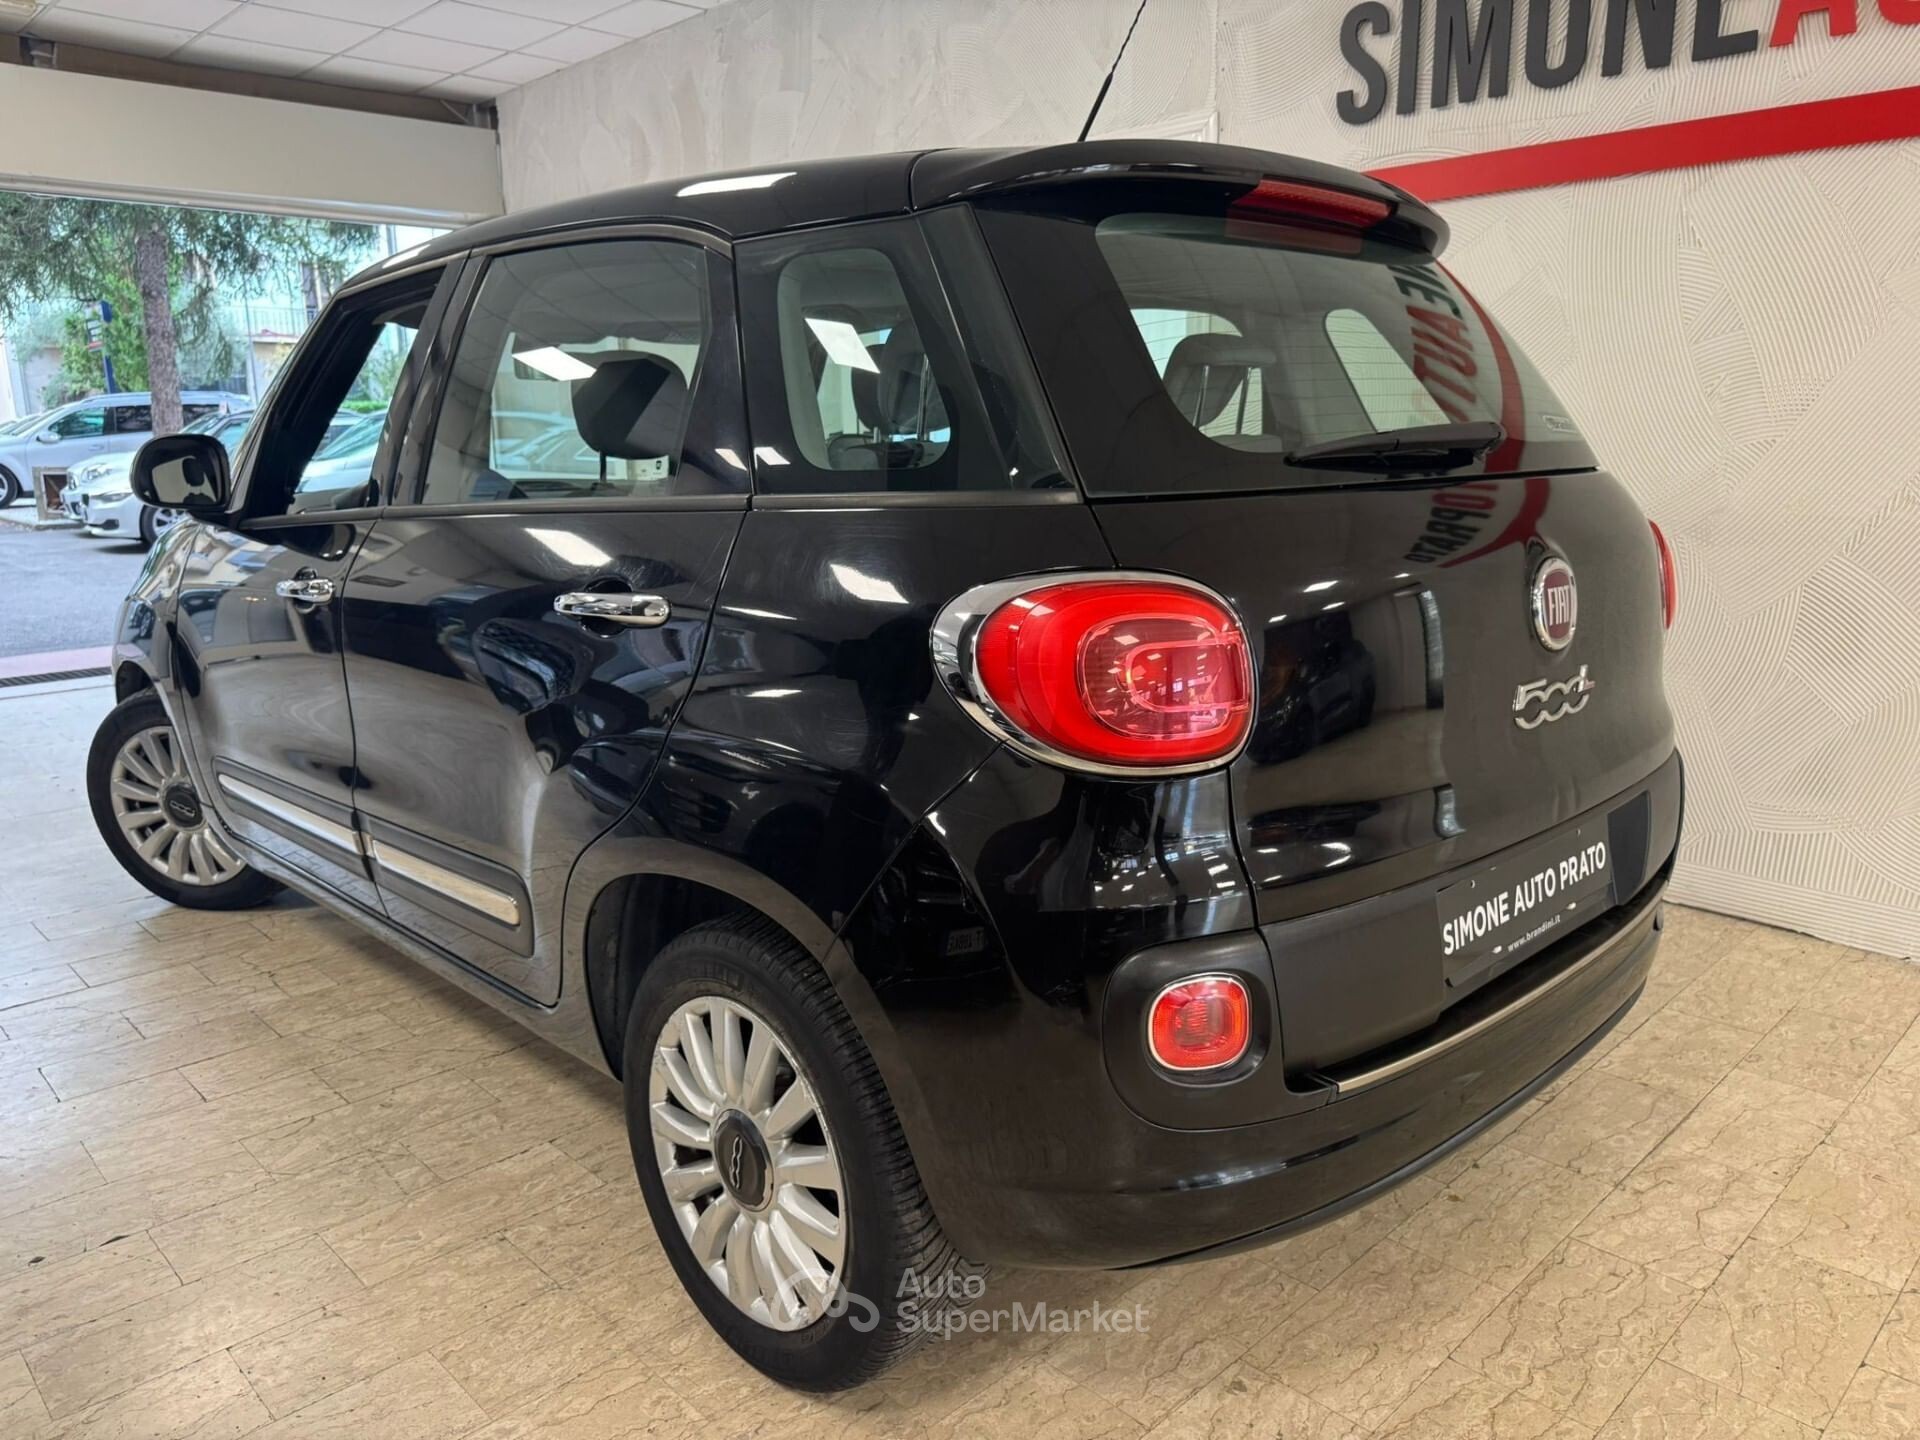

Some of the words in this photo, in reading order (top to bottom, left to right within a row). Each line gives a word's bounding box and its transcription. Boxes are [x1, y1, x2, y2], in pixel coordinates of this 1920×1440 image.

[1547, 585, 1570, 626] FIAT
[1443, 891, 1510, 955] SIMONE
[1513, 868, 1556, 917] AUTO
[1560, 841, 1606, 890] PRATO
[1507, 914, 1561, 952] www.brandini.it
